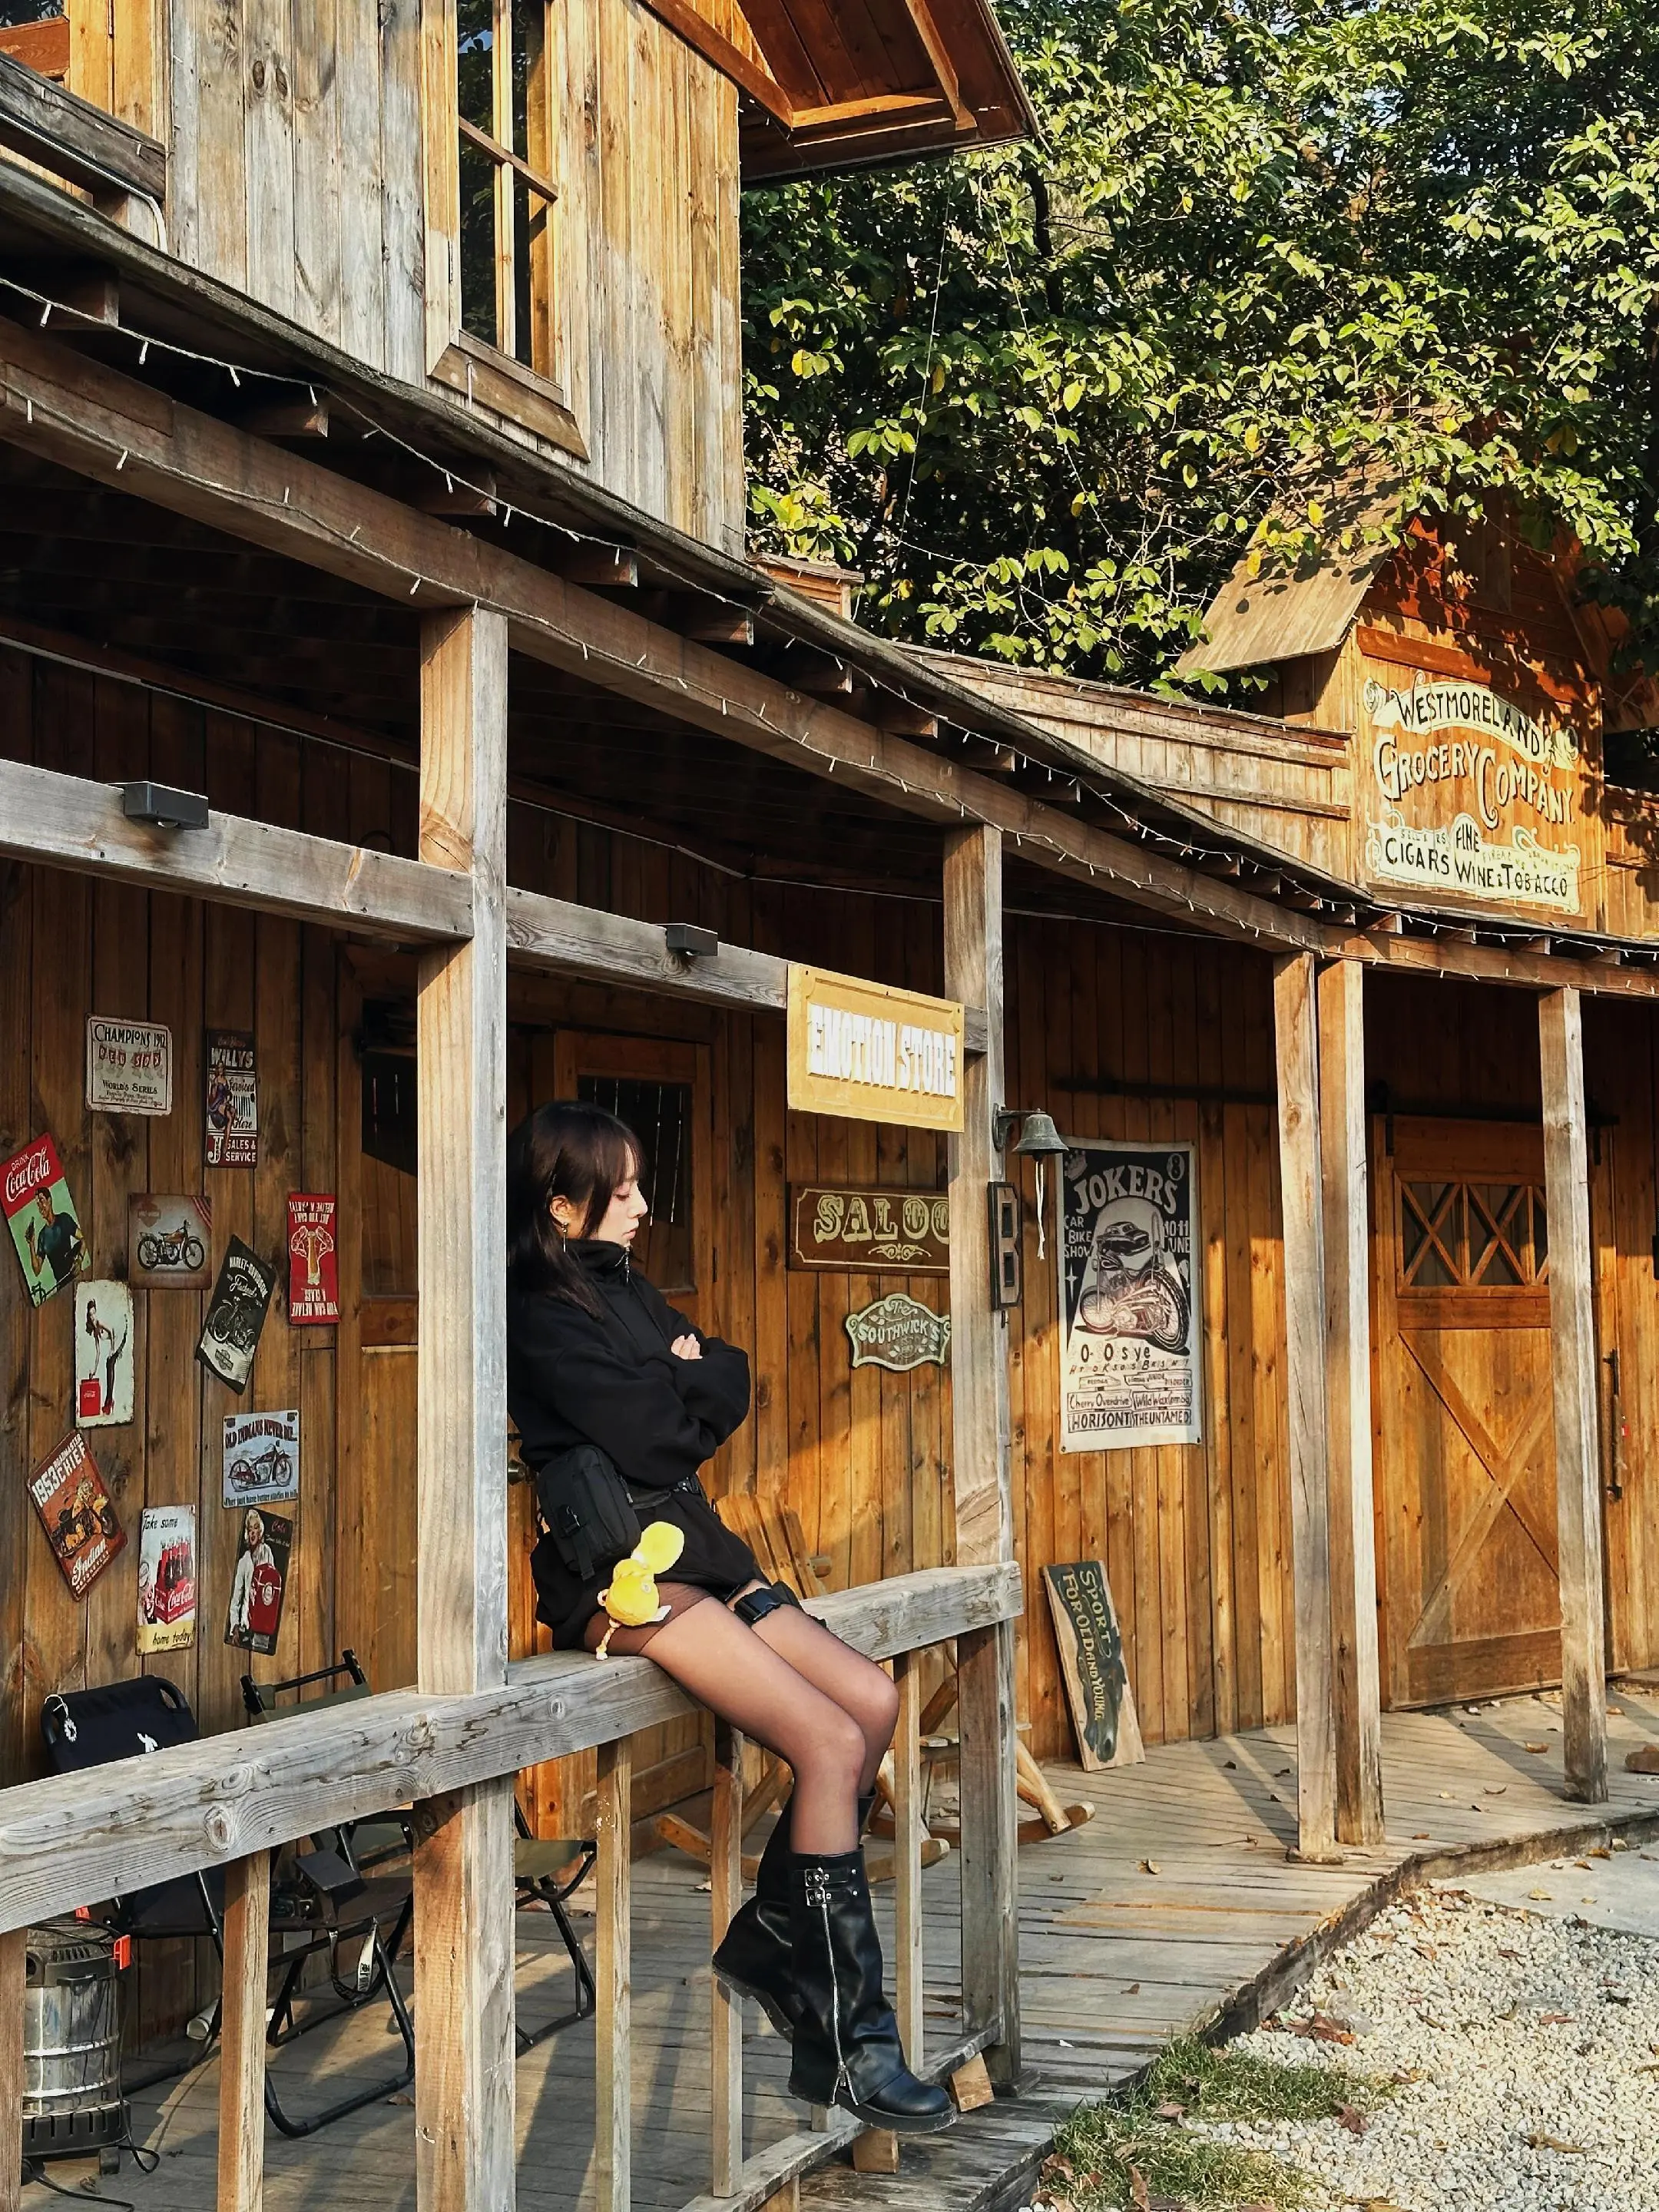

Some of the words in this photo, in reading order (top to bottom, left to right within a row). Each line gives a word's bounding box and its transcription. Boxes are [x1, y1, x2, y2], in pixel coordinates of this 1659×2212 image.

[1391, 680, 1540, 757] WESTMORELAND
[1374, 733, 1481, 802] GROCERY
[1477, 747, 1574, 830] COMPANY
[1455, 823, 1480, 853] FINE
[1385, 837, 1450, 875] CIGARS
[1455, 859, 1495, 888] WINE
[1501, 863, 1568, 897] TOBACCO
[134, 1051, 161, 1068] SOX
[211, 1048, 253, 1068] WILLYS
[806, 1002, 897, 1088] EMOTION
[899, 1024, 957, 1097] STORE
[226, 1152, 256, 1162] SERVICE
[1074, 1164, 1178, 1214] JOKERS
[1064, 1245, 1094, 1258] SHOW
[1068, 1230, 1092, 1244] BIKE
[1164, 1237, 1190, 1253] JUNE
[857, 1320, 941, 1344] SOUTHWICK'S
[1070, 1392, 1094, 1409] Cherry
[1071, 1411, 1131, 1430] HORISONT
[58, 1441, 86, 1480] CHIEF
[31, 1465, 61, 1508] 1953
[71, 1538, 107, 1586] Indian
[1063, 1573, 1083, 1613] FOR
[1076, 1614, 1094, 1651] OLD
[1080, 1569, 1111, 1644] SPORT
